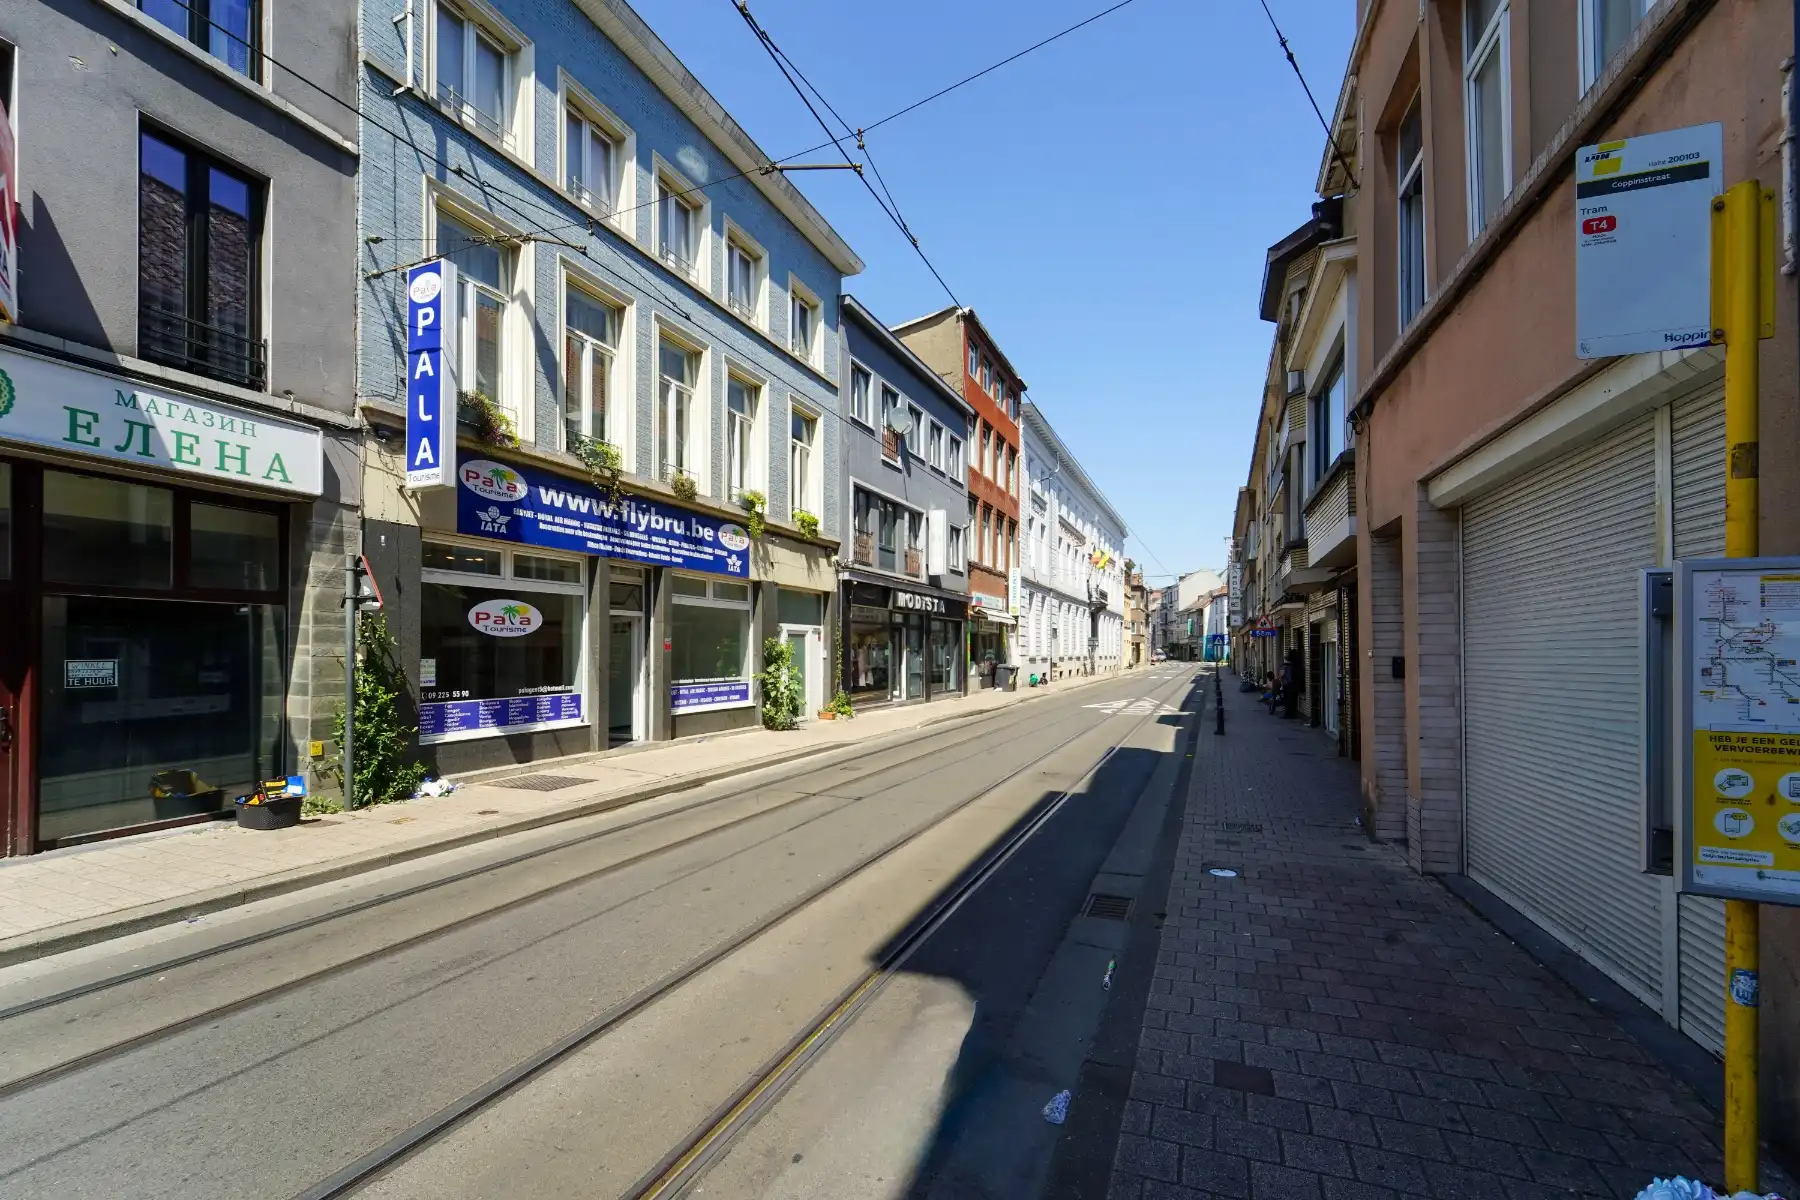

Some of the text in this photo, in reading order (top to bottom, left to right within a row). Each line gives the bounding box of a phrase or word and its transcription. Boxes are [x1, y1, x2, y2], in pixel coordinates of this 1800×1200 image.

[1668, 152, 1700, 164] 200103
[1611, 173, 1671, 188] Coppinsstraat
[1580, 204, 1608, 216] Tram
[1590, 218, 1608, 231] T4
[415, 307, 435, 466] PALA
[114, 388, 258, 438] МАГАЗИН
[63, 405, 293, 484] ЕЛЕНА
[408, 472, 440, 484] Tourisme
[472, 484, 514, 499] Tourisme
[538, 485, 714, 541] www.flybru.be
[480, 521, 507, 534] IATA
[728, 564, 740, 573] IATA
[68, 677, 114, 686] TE HUUR
[452, 690, 461, 698] 55
[462, 690, 470, 698] 90
[1709, 735, 1732, 743] HEB
[1736, 736, 1748, 744] JE
